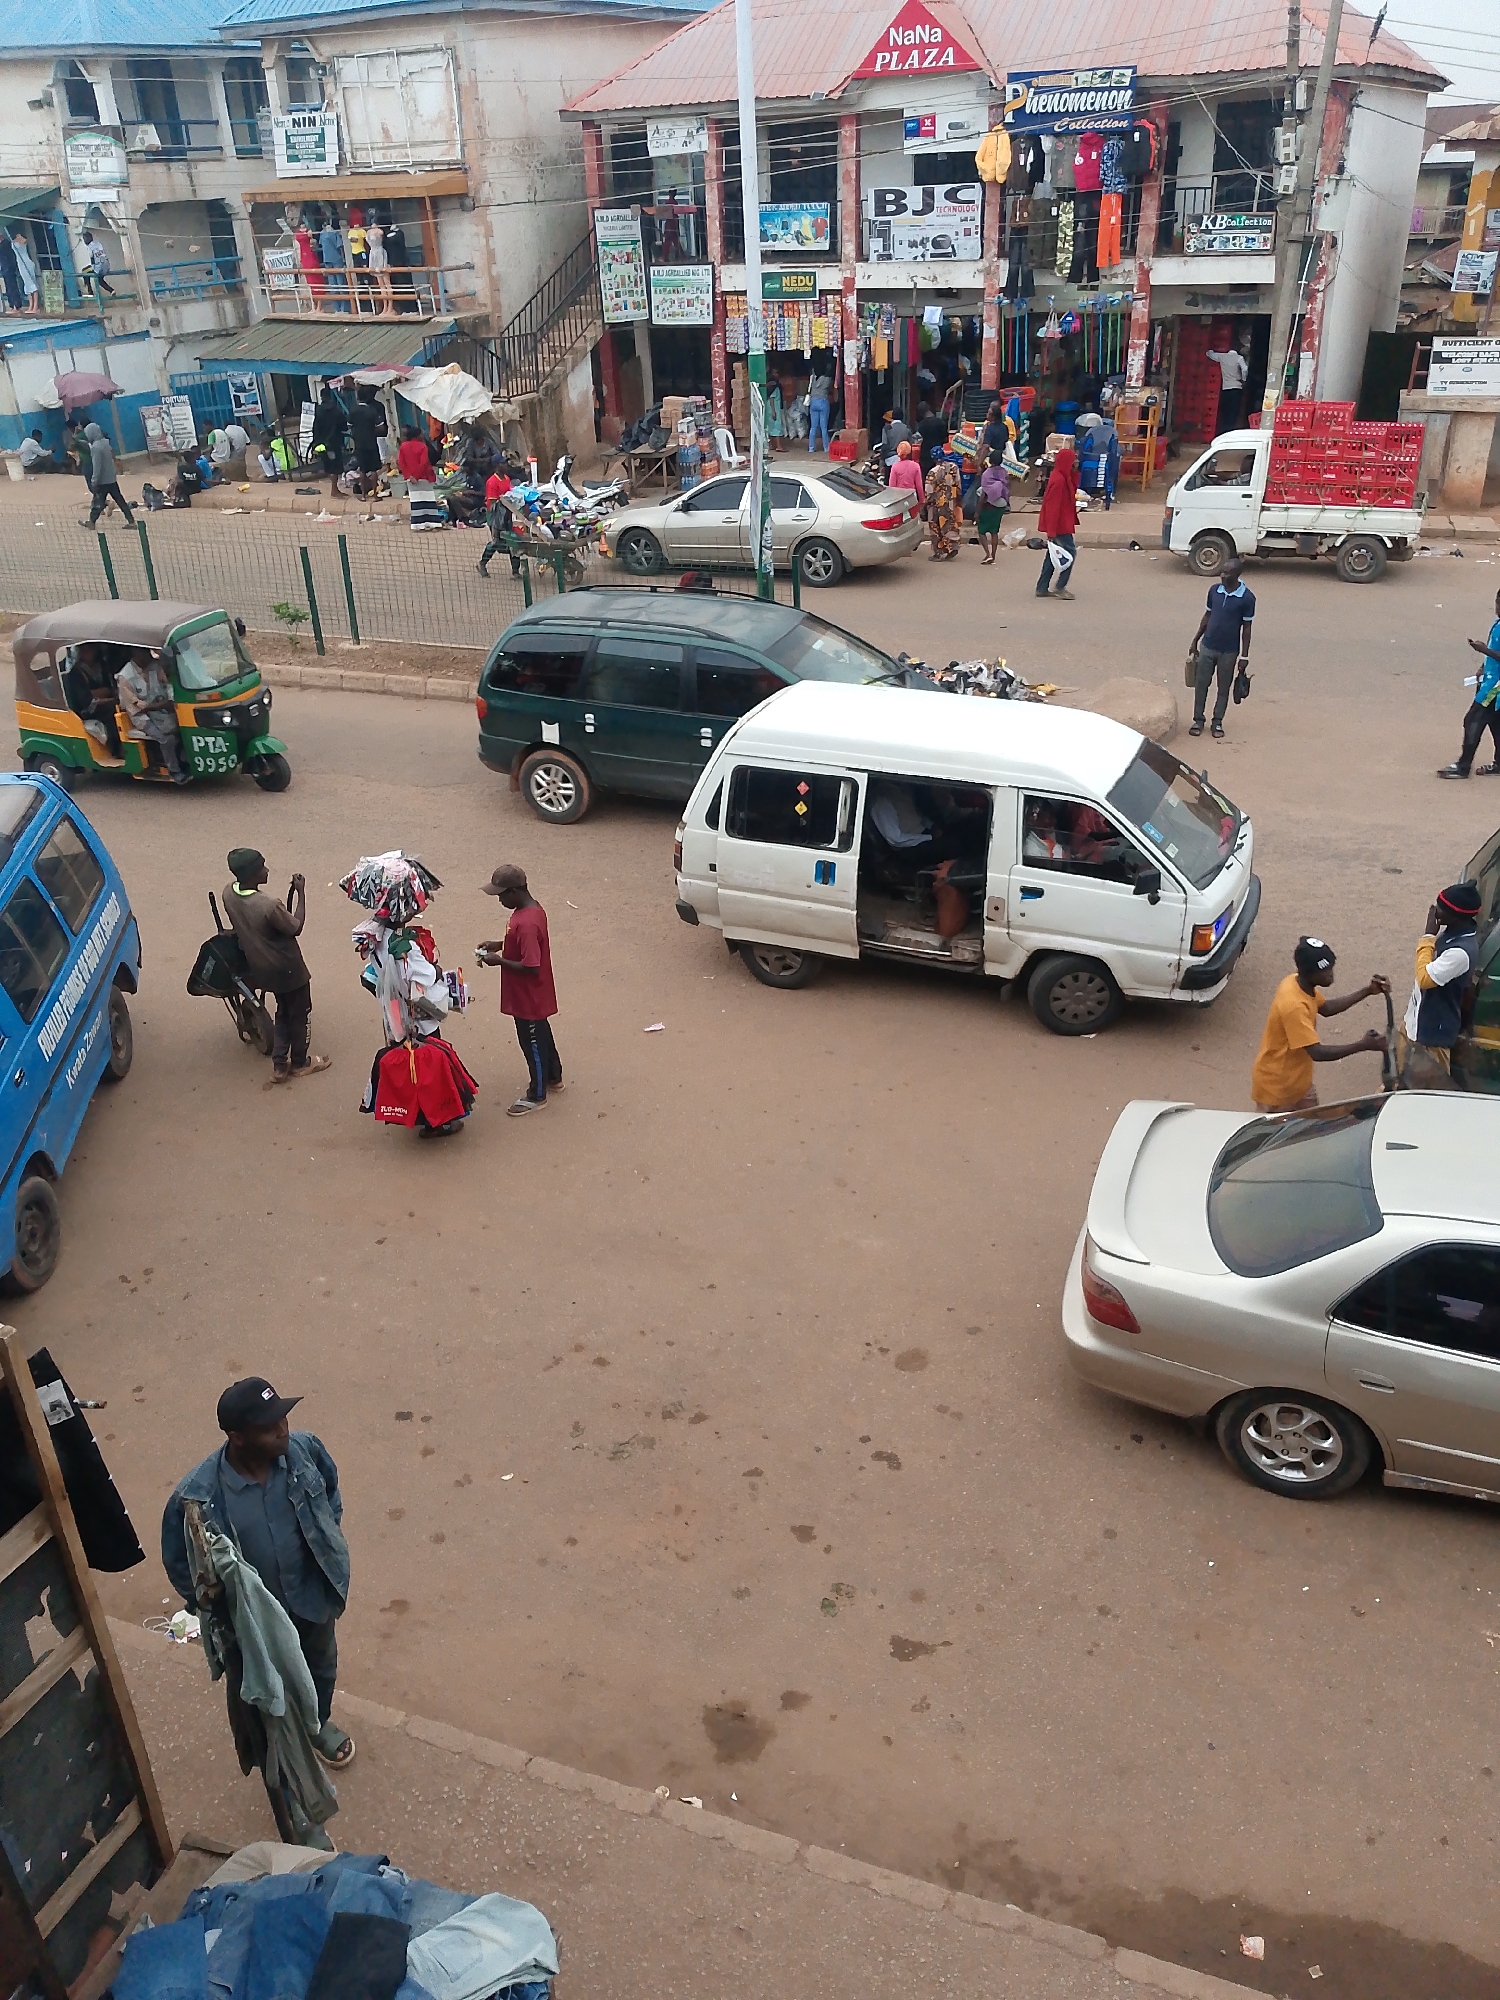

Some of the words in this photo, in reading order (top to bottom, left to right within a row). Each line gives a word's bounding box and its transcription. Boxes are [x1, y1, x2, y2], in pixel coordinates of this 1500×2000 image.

[889, 25, 942, 46] NaNa
[874, 47, 955, 72] PLAZA
[1003, 83, 1134, 123] Phenomenon
[292, 116, 316, 128] NIN
[1054, 117, 1129, 132] Collection
[874, 185, 976, 217] BJC
[936, 204, 979, 213] TECHNOLOGY
[1200, 214, 1227, 229] KB
[782, 275, 814, 287] NEDU
[162, 395, 189, 404] FORTUNE
